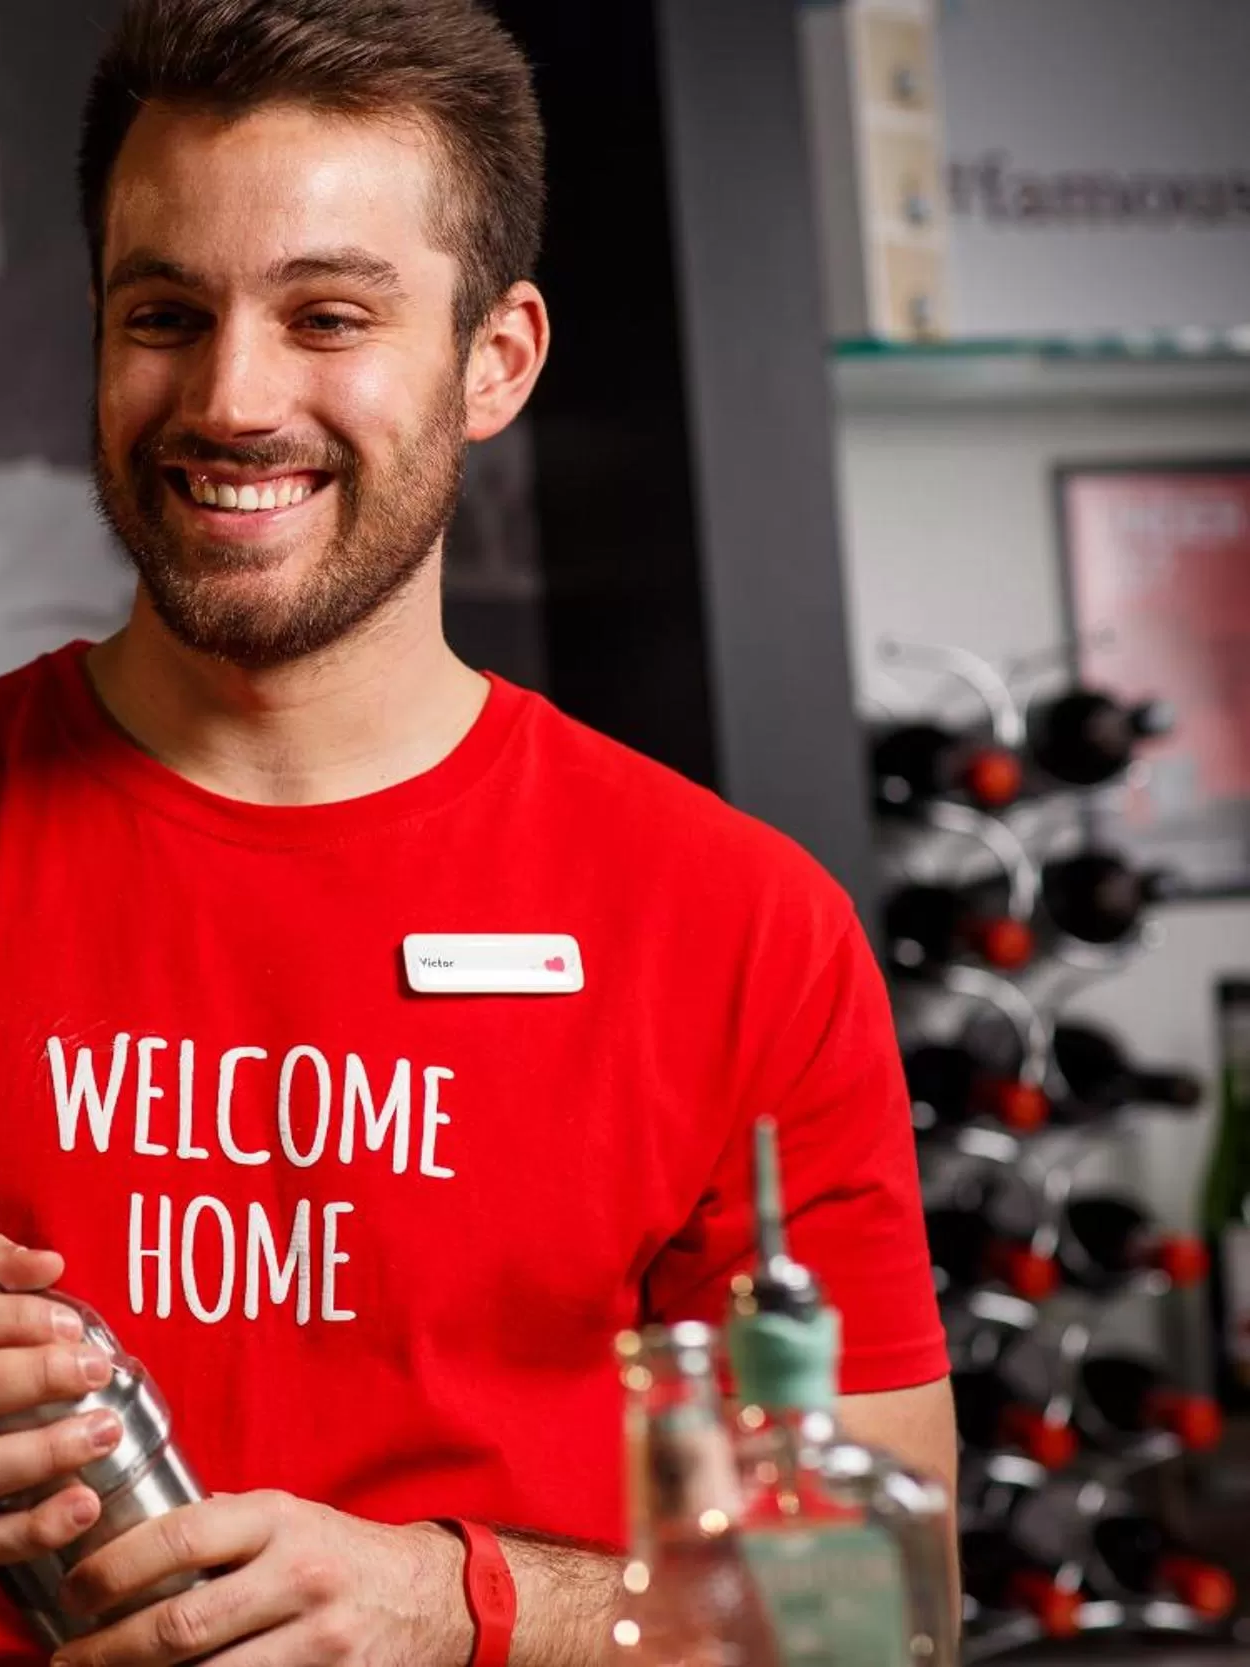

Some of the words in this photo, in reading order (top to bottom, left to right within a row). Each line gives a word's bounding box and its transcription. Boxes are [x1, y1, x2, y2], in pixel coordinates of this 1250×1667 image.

[418, 956, 455, 969] Victor
[47, 1032, 456, 1178] WELCOME
[128, 1192, 357, 1326] HOME
